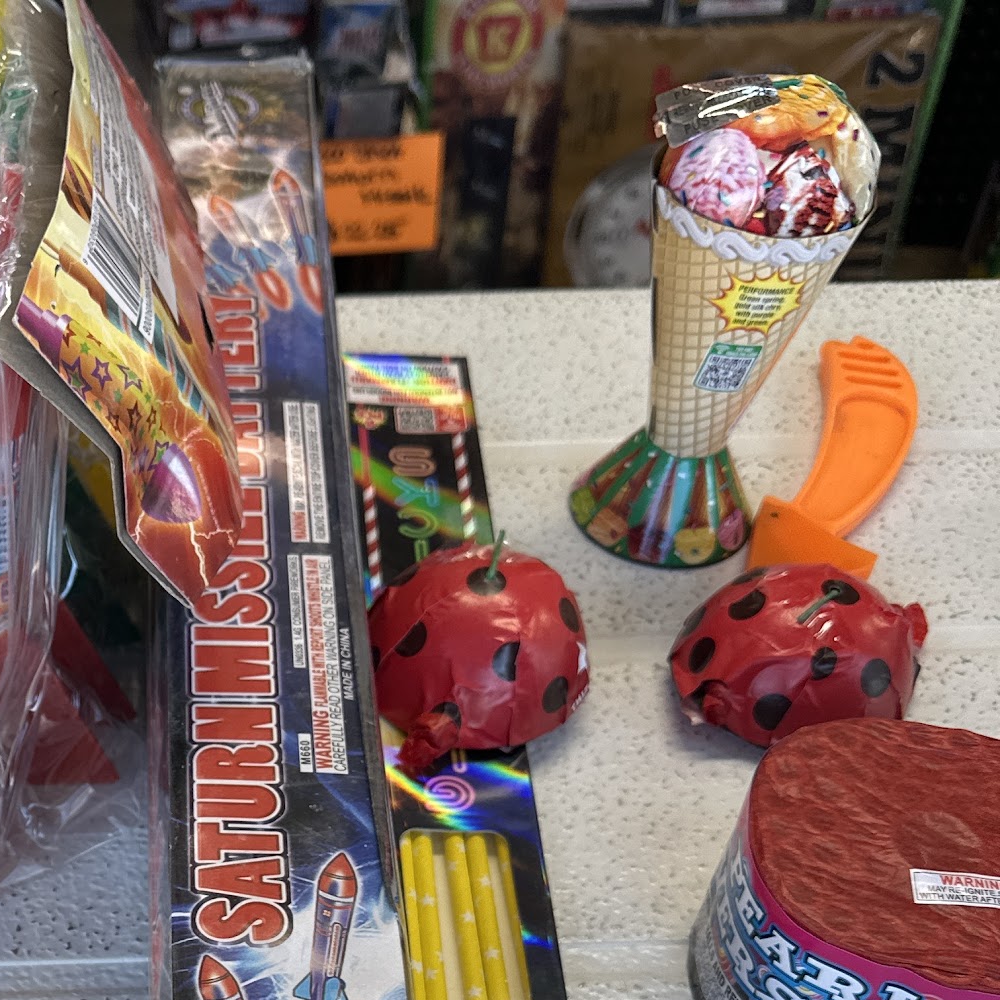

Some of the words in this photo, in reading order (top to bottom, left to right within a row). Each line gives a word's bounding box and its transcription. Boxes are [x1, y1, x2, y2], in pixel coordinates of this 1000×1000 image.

[319, 559, 332, 585] PANEL
[321, 585, 333, 606] SIDE
[322, 606, 334, 620] ON
[310, 627, 325, 652] REPORT
[323, 620, 338, 662] WARNING
[339, 627, 351, 658] CHINA
[312, 650, 325, 669] WITH
[340, 660, 351, 671] IN
[313, 668, 328, 708] FLAMMABLE
[326, 662, 340, 694] OTHER
[341, 671, 354, 701] MADE
[328, 694, 342, 720] READ
[301, 740, 312, 765] M660
[312, 711, 332, 770] WARNING
[330, 720, 347, 772] CAREFULLY
[194, 704, 289, 944] SATURN
[927, 884, 947, 893] MAY
[940, 875, 1000, 890] WARNIN
[919, 892, 945, 901] WITH
[945, 894, 979, 903] WATER
[980, 896, 1000, 905] AFTE
